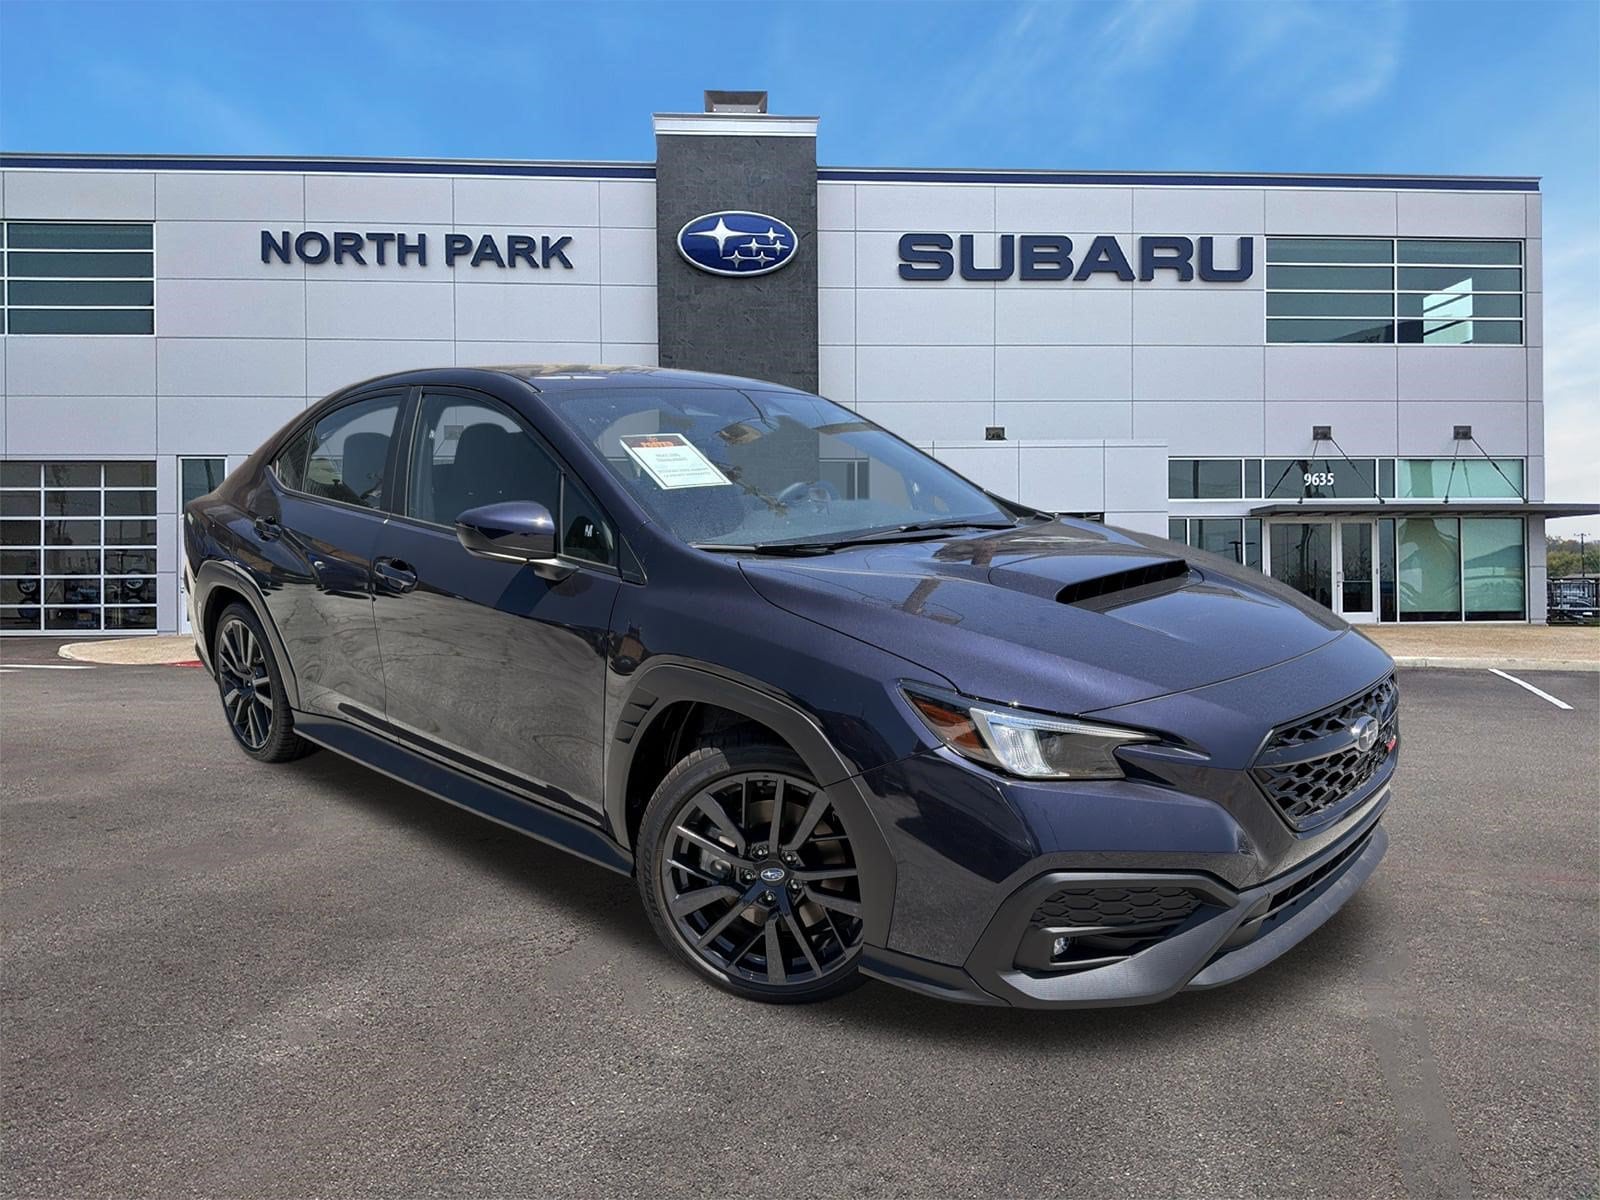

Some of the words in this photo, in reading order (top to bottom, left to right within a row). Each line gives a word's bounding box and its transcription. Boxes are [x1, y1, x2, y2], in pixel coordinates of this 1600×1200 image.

[260, 230, 427, 267] NORTH
[445, 233, 574, 269] PARK
[898, 233, 1254, 282] SUBARU
[1304, 472, 1335, 486] 9635
